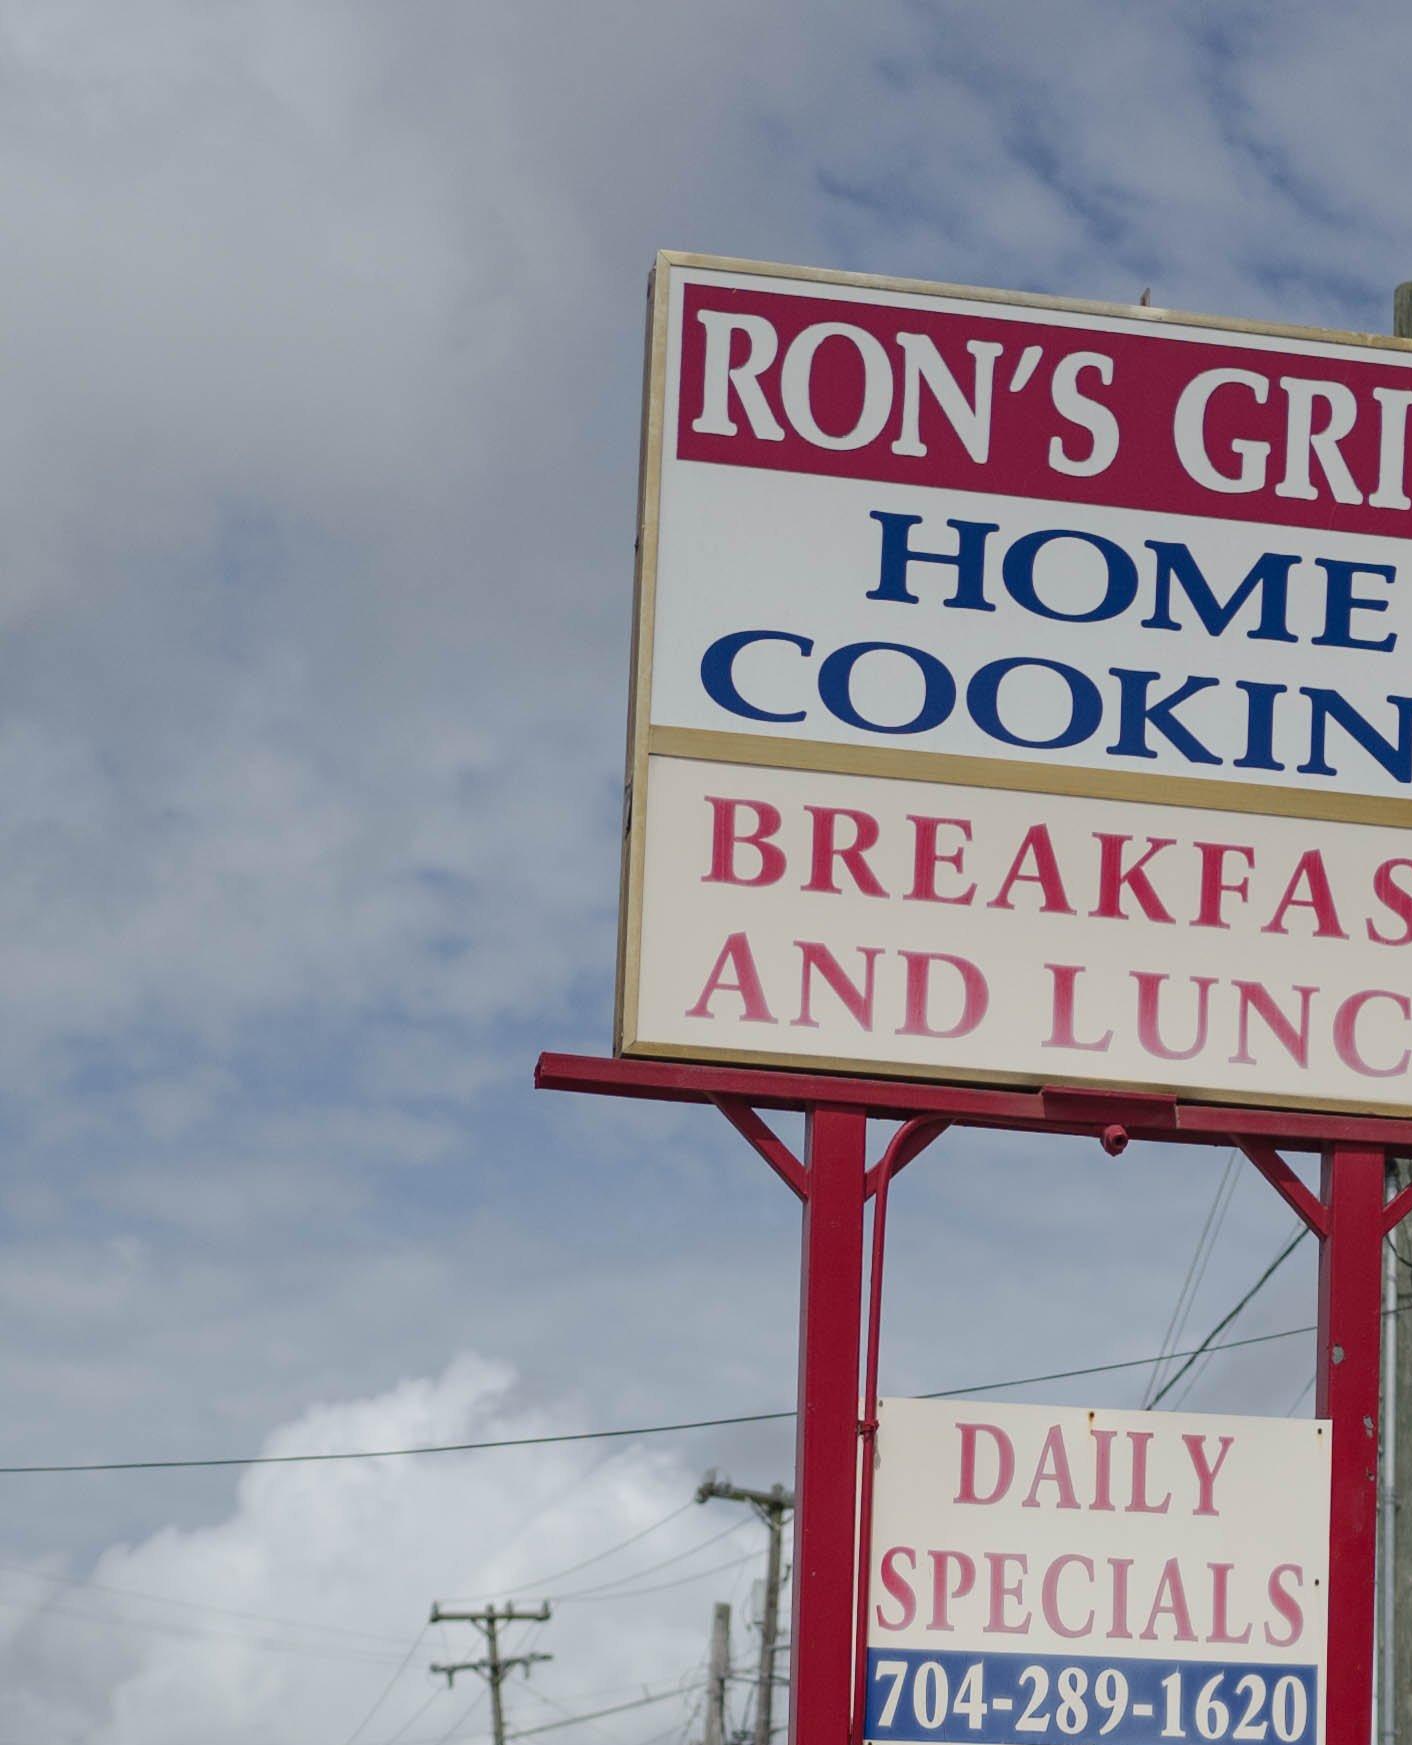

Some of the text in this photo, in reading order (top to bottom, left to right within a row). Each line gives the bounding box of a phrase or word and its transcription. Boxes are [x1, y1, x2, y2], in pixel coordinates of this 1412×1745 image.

[692, 309, 1120, 477] RON'S
[866, 510, 1399, 653] HOME
[685, 931, 990, 1038] AND
[953, 1422, 1234, 1517] DAILY
[876, 1546, 1304, 1648] SPECIALS
[874, 1658, 1308, 1742] 704-289-1620
